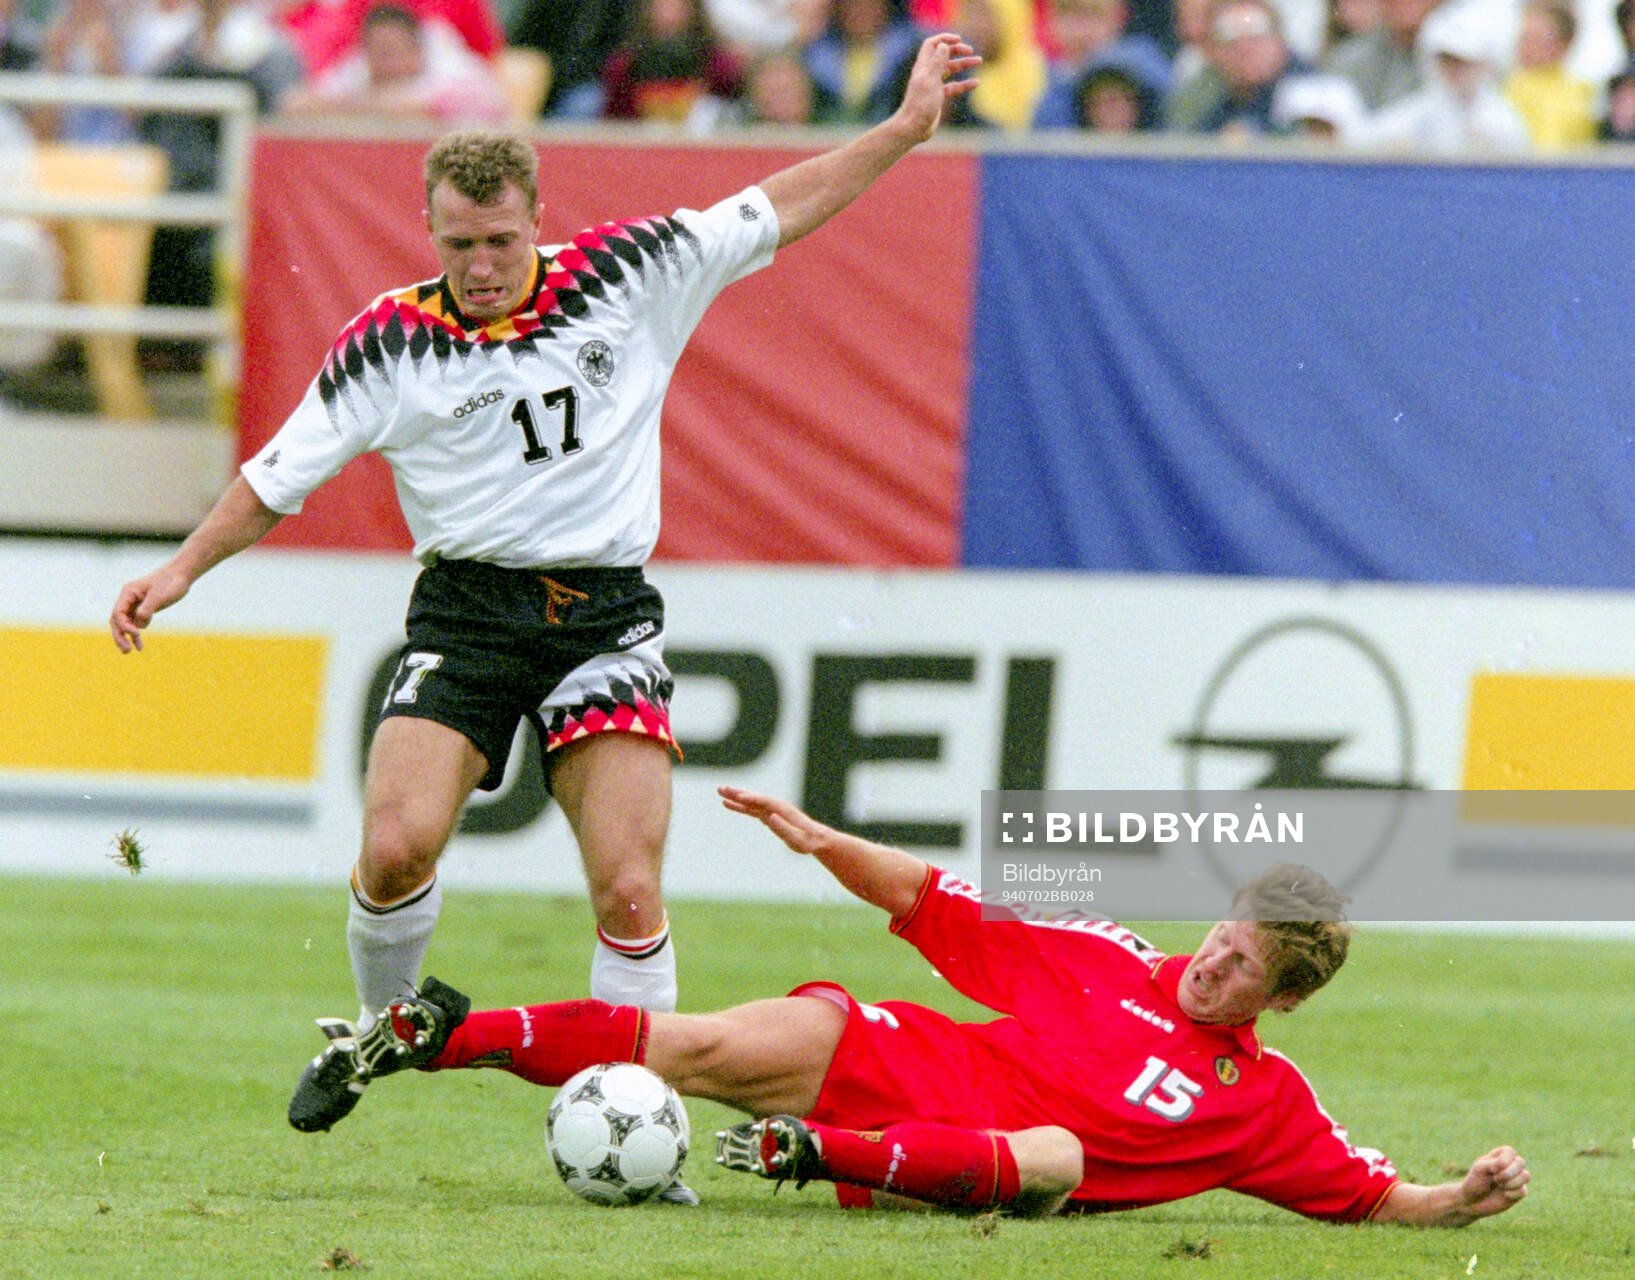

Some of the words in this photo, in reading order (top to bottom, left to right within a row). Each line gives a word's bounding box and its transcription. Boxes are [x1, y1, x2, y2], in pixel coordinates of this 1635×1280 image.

[453, 387, 505, 419] adidas
[511, 385, 584, 465] 17
[617, 620, 655, 646] adidas
[381, 652, 443, 713] 7
[360, 646, 1160, 854] PEL
[1123, 1055, 1204, 1122] 15
